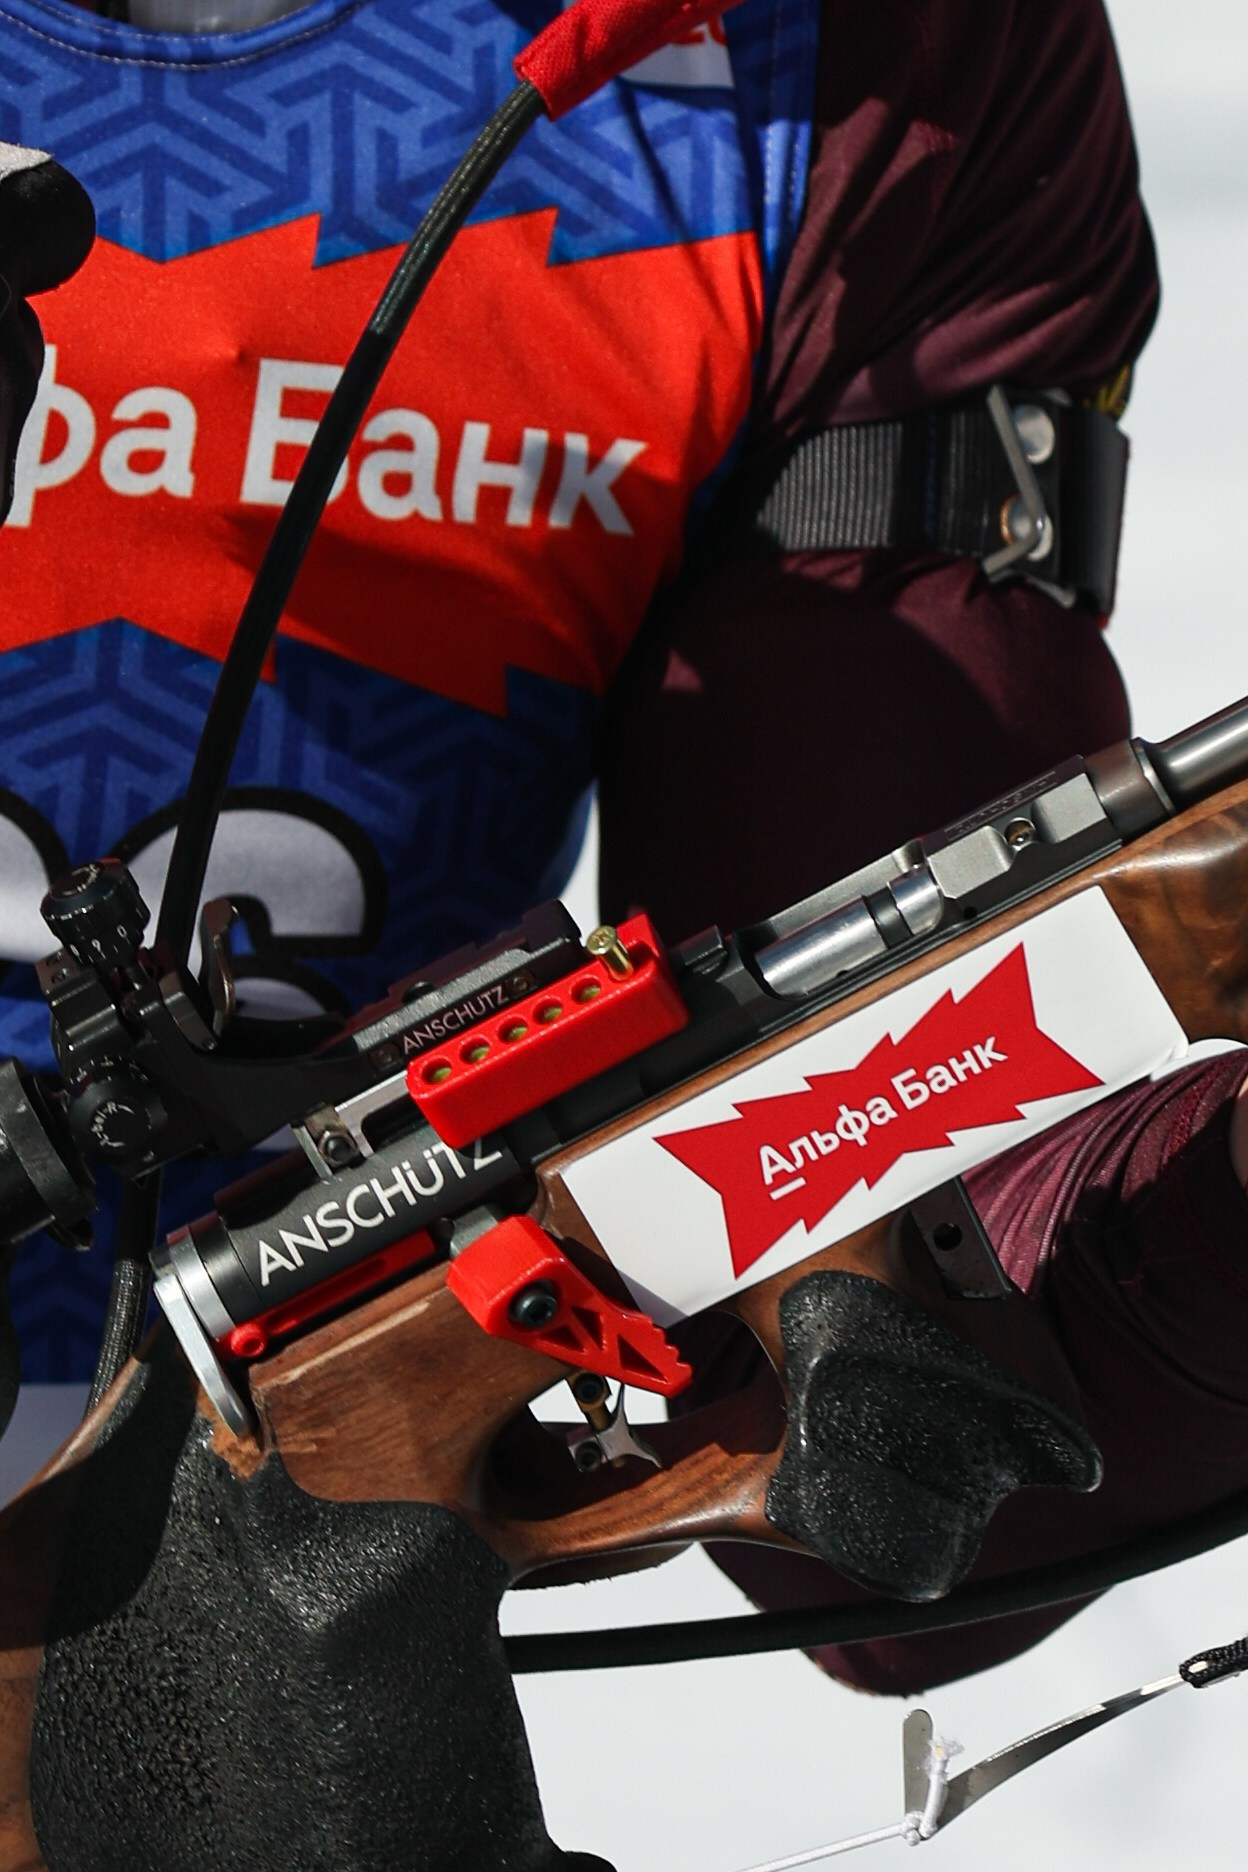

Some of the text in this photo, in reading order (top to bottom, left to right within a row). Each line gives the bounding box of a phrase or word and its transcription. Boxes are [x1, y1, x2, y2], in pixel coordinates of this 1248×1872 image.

[240, 357, 649, 537] Банк
[759, 1036, 1009, 1198] Альфа Банк
